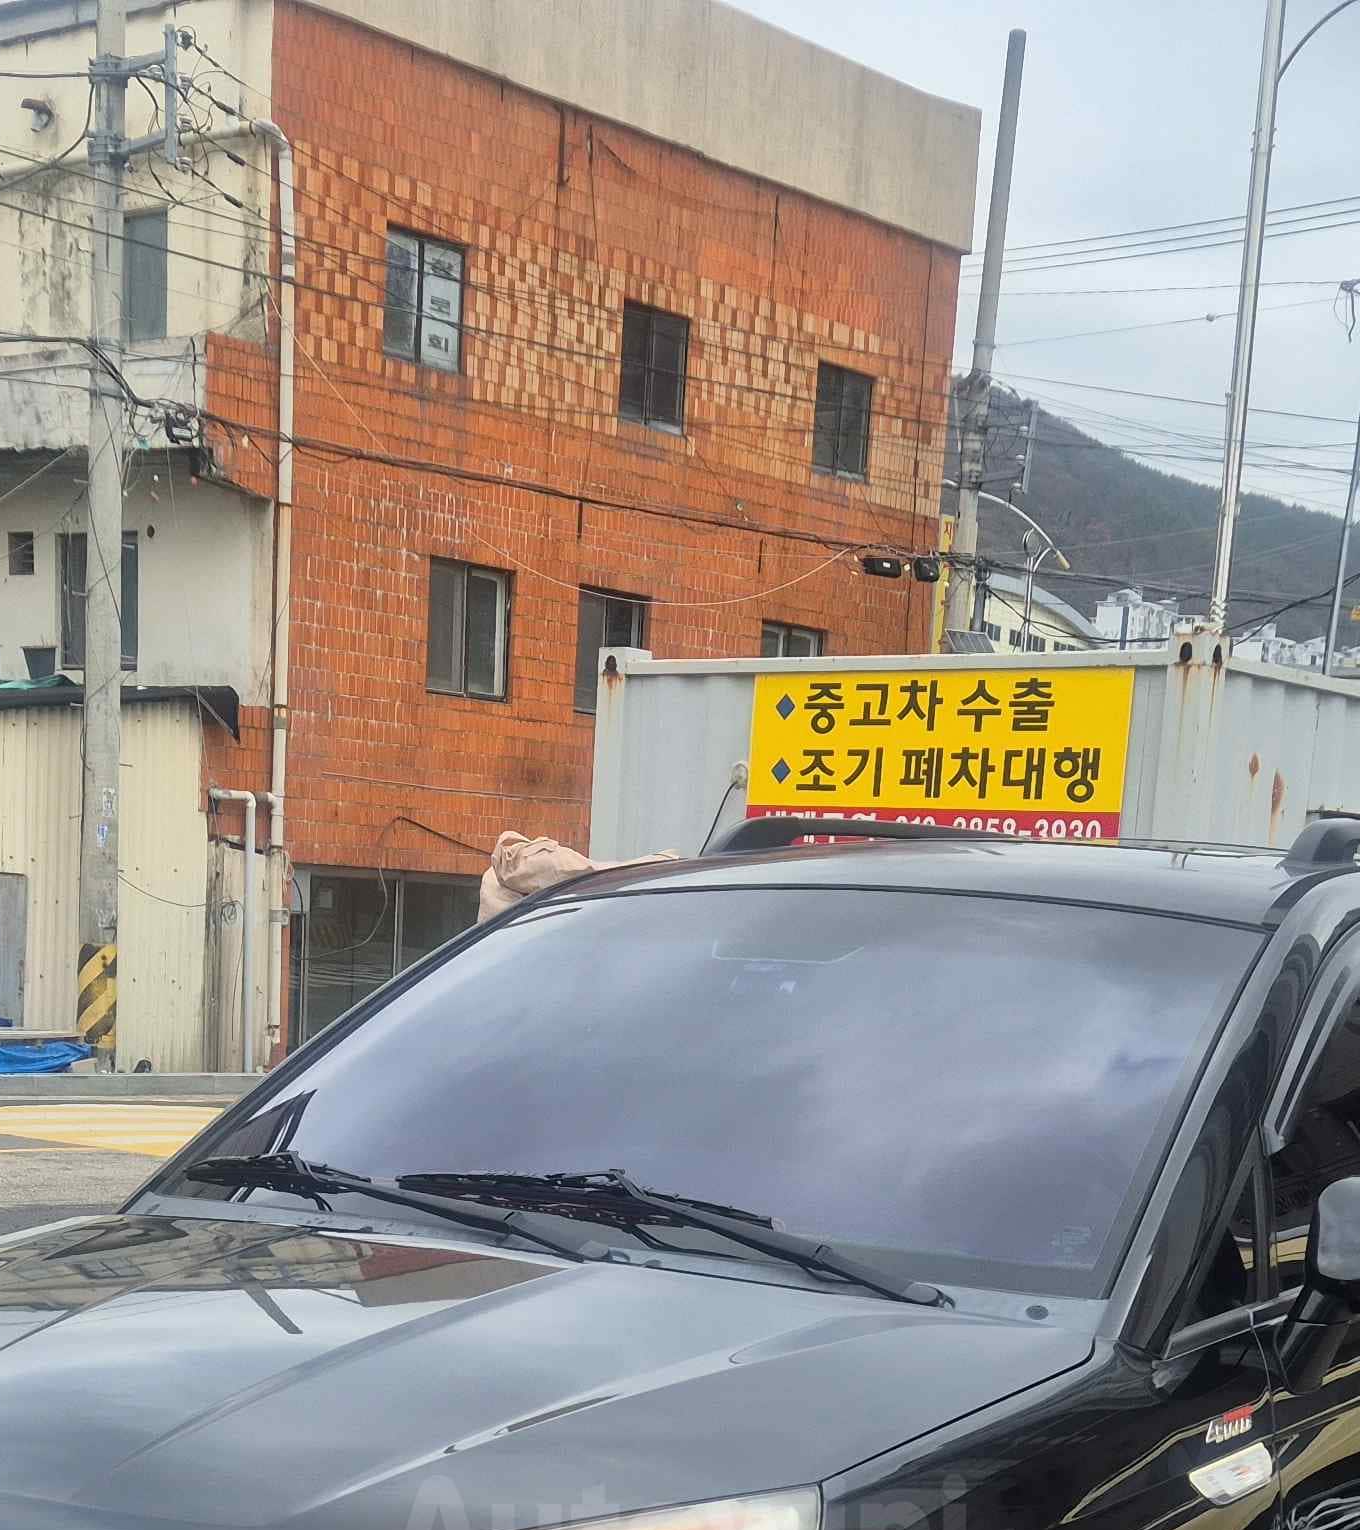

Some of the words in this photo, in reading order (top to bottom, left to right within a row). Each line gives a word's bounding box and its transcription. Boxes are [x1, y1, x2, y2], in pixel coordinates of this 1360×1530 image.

[804, 679, 944, 735] 중고차
[957, 677, 1056, 733] 수출
[795, 747, 884, 798] 조기
[899, 746, 1102, 804] 폐차대행
